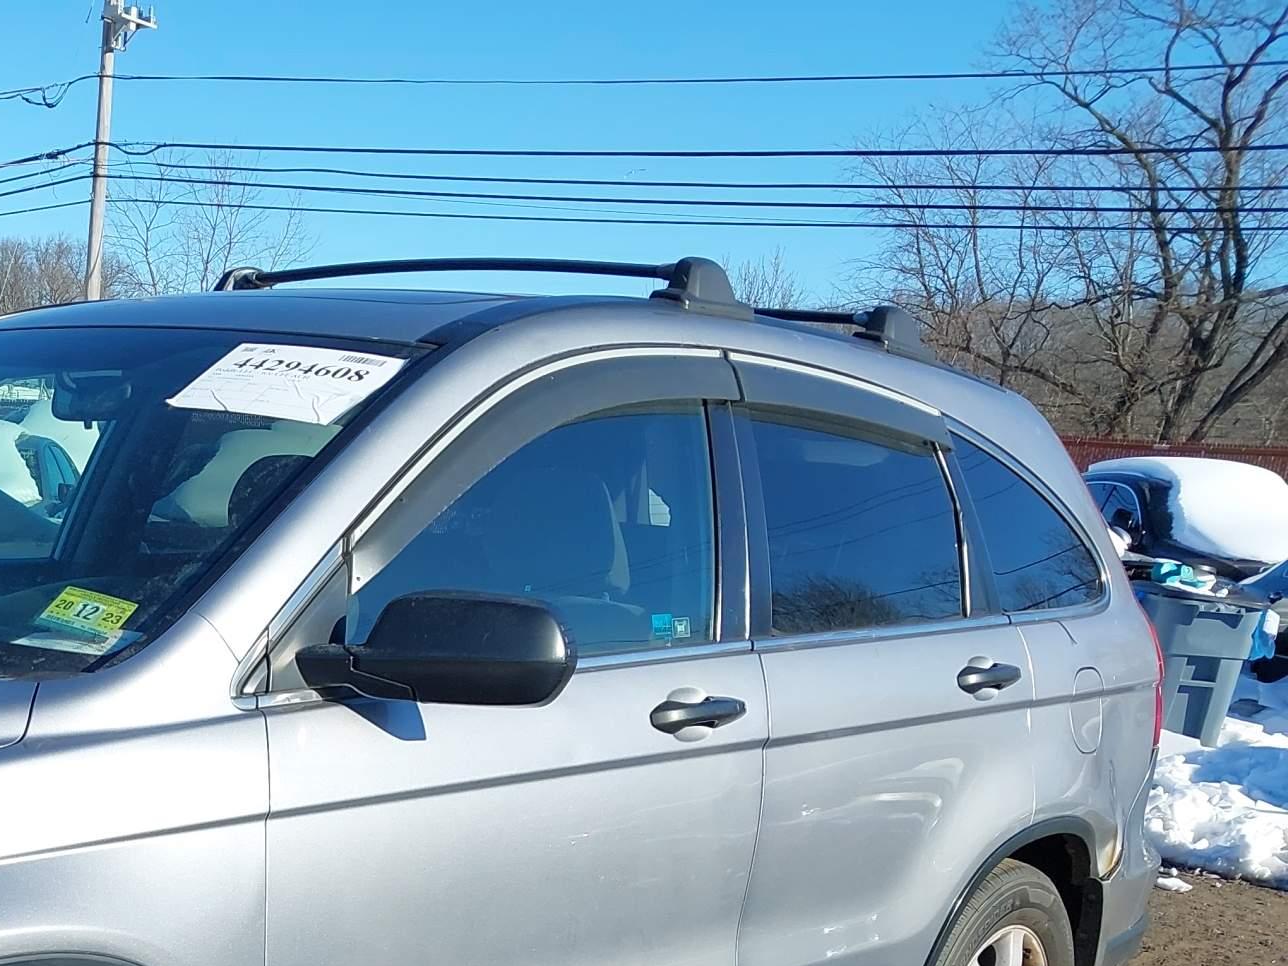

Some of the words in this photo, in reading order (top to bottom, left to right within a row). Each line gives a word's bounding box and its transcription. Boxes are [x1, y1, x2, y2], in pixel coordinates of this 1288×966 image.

[234, 356, 371, 382] 44294608
[55, 599, 75, 611] 20
[73, 602, 100, 621] 12
[102, 612, 123, 625] 23
